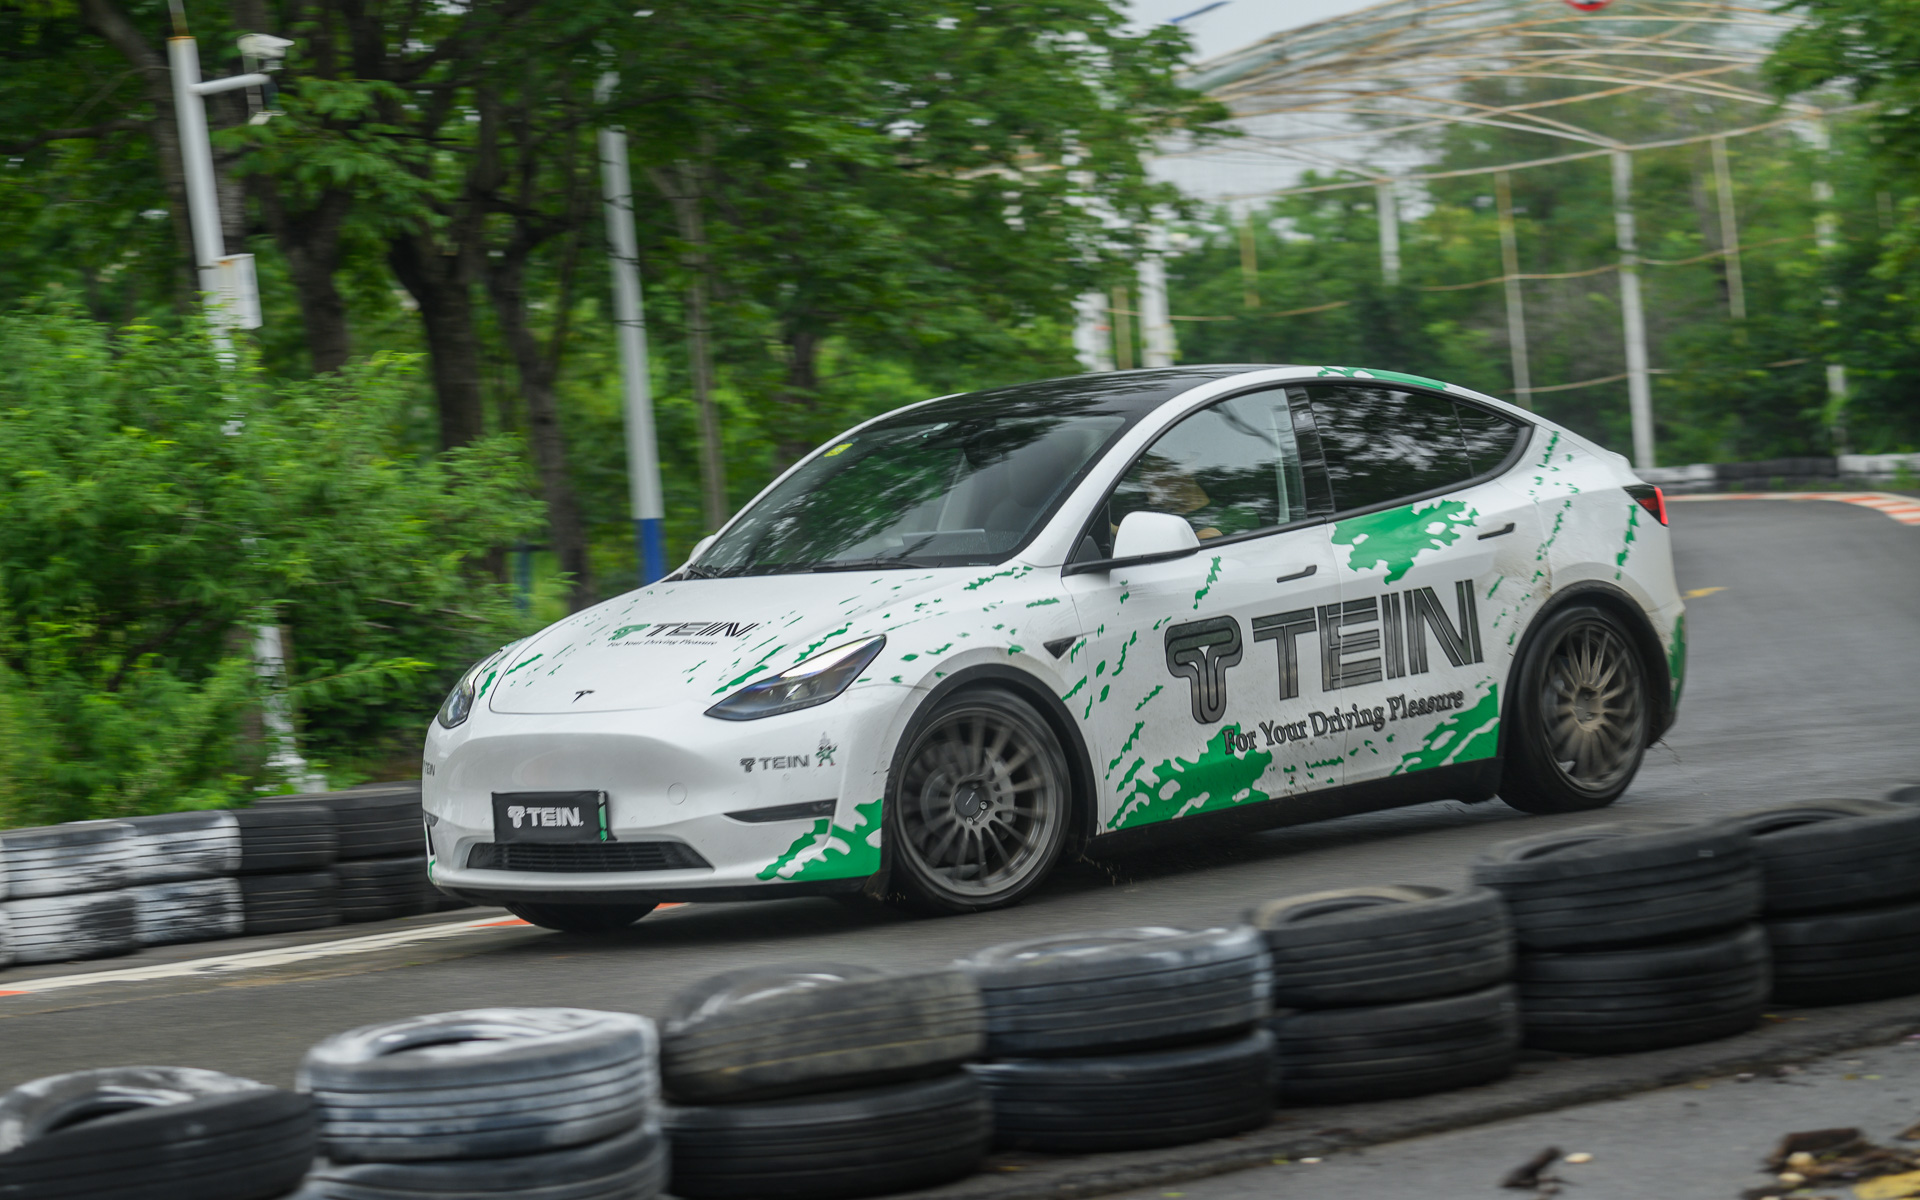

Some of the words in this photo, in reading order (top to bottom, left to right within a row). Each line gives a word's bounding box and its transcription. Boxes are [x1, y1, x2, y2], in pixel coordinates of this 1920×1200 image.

[645, 621, 760, 637] TEIN
[1251, 579, 1484, 701] TEIN
[1222, 728, 1257, 755] For
[1259, 720, 1308, 746] Your
[1308, 704, 1386, 732] Driving
[1386, 690, 1465, 722] Pleasure
[758, 754, 810, 771] TEIN
